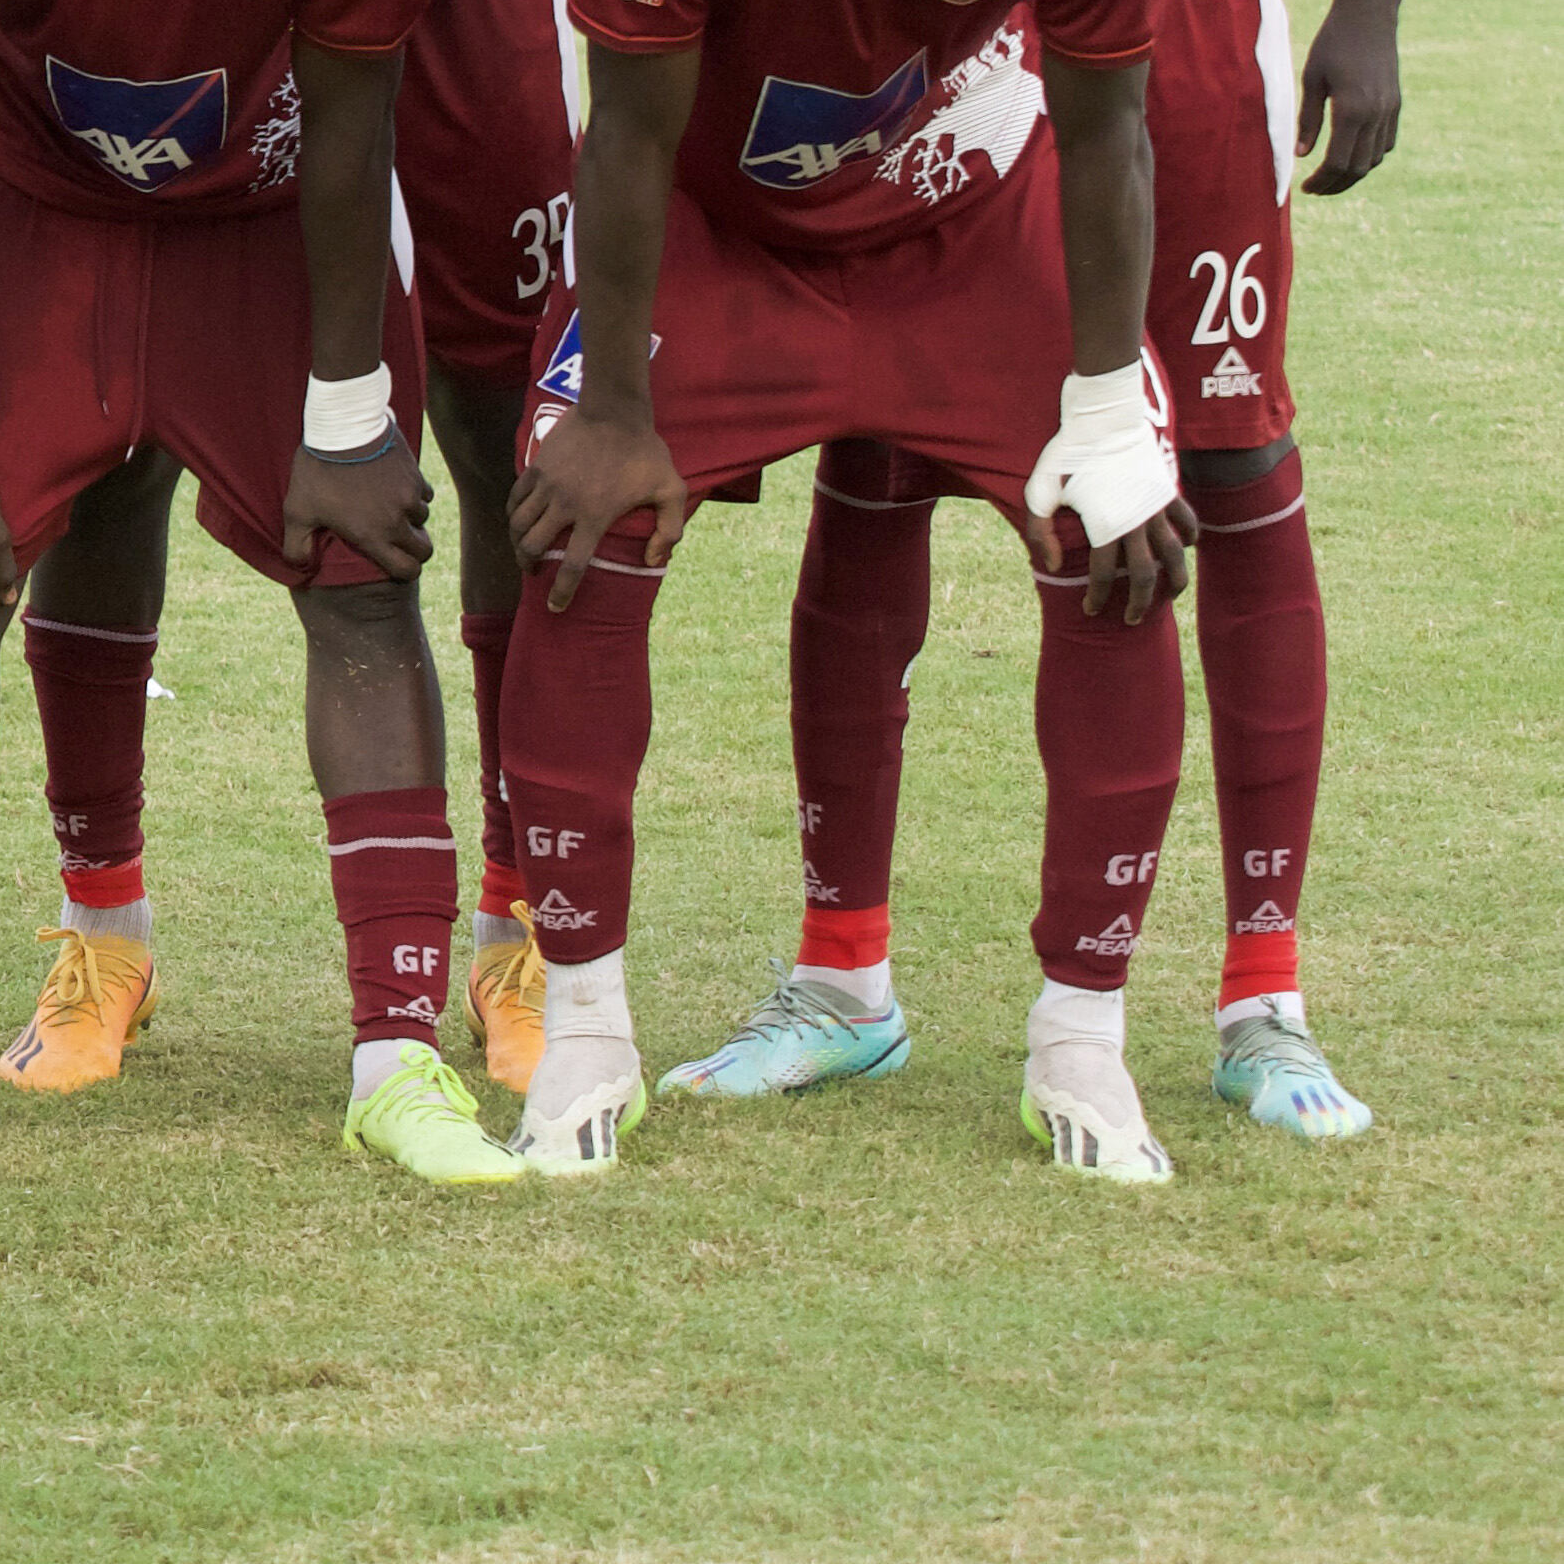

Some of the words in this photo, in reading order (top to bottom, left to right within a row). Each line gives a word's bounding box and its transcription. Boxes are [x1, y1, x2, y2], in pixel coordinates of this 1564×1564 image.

[67, 128, 193, 181] AXA
[743, 130, 882, 181] AXA
[1188, 243, 1267, 344] 26
[1201, 373, 1262, 398] PEAK
[527, 825, 585, 859] GF
[1104, 851, 1157, 887] GF
[1244, 848, 1291, 878] GF
[531, 906, 598, 931] PEAK
[1236, 917, 1295, 935] PEAK
[393, 944, 439, 976] GF
